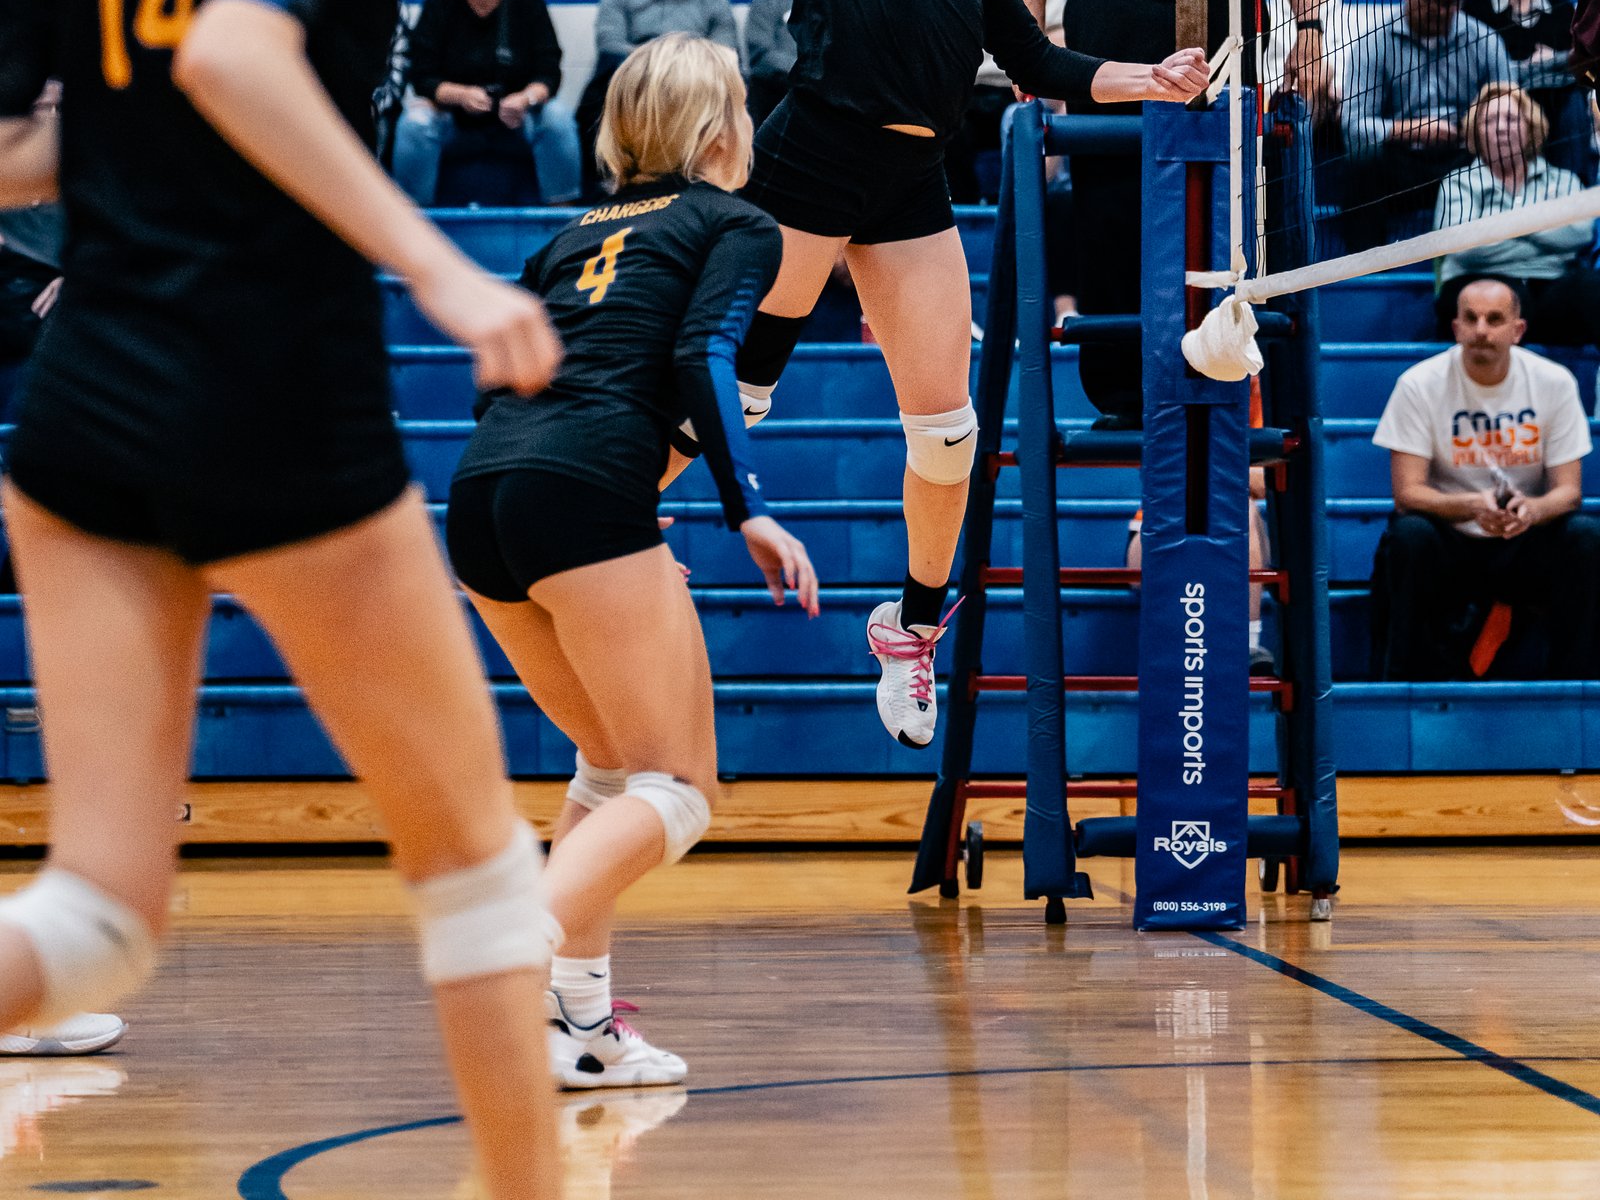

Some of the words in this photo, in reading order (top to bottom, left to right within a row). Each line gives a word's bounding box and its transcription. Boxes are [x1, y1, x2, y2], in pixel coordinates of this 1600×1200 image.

[575, 226, 634, 305] 4
[1179, 582, 1208, 672] sports
[1177, 676, 1207, 786] imports
[1153, 837, 1228, 856] Royals
[1153, 901, 1179, 913] (800)
[1180, 902, 1227, 912] 556-3198
